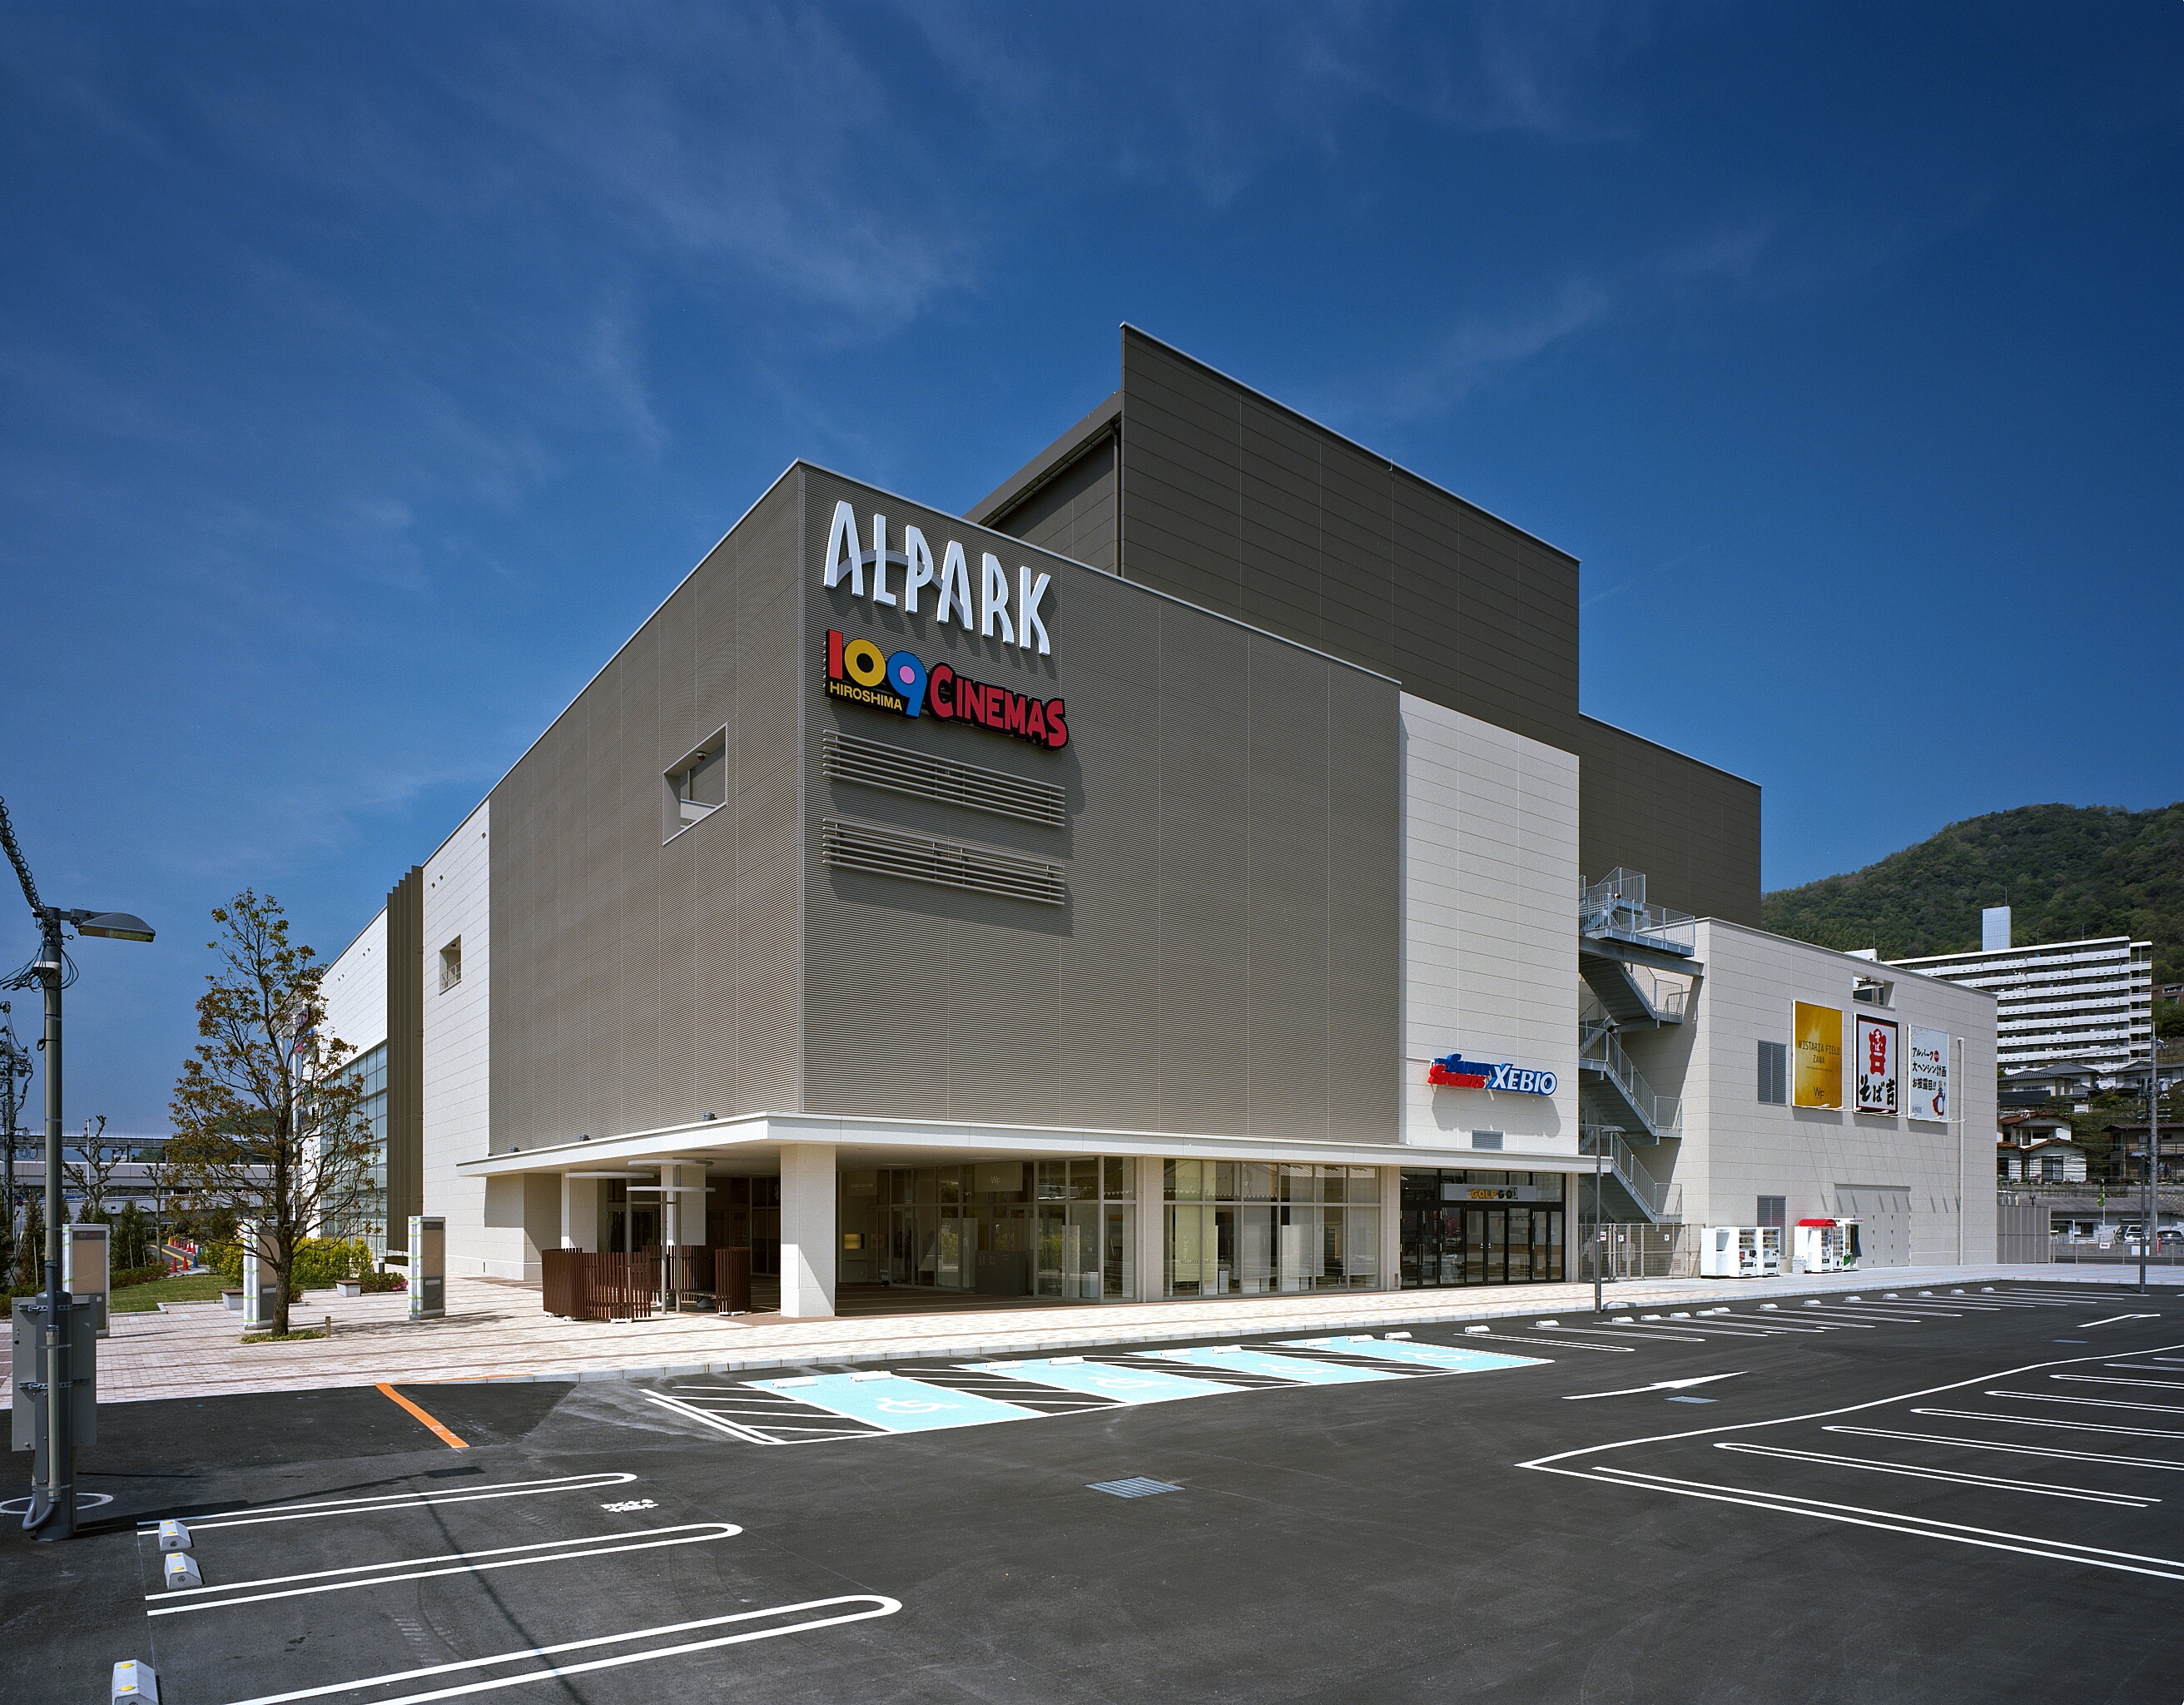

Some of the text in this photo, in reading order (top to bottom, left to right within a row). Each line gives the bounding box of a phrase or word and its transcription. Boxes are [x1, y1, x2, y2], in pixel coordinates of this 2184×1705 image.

[823, 500, 1050, 655] ALPARK
[826, 629, 1069, 748] 109 CINEMAS
[829, 681, 902, 711] HIROSHIMA
[1798, 1040, 1840, 1056] WISTARIA FIELD
[1813, 1054, 1825, 1064] ZAWA
[1912, 1046, 1933, 1061] アルパーク
[1489, 1064, 1557, 1096] XEBIO
[1912, 1061, 1947, 1077] 大ヘンシン計画
[1859, 1073, 1895, 1106] そば吉
